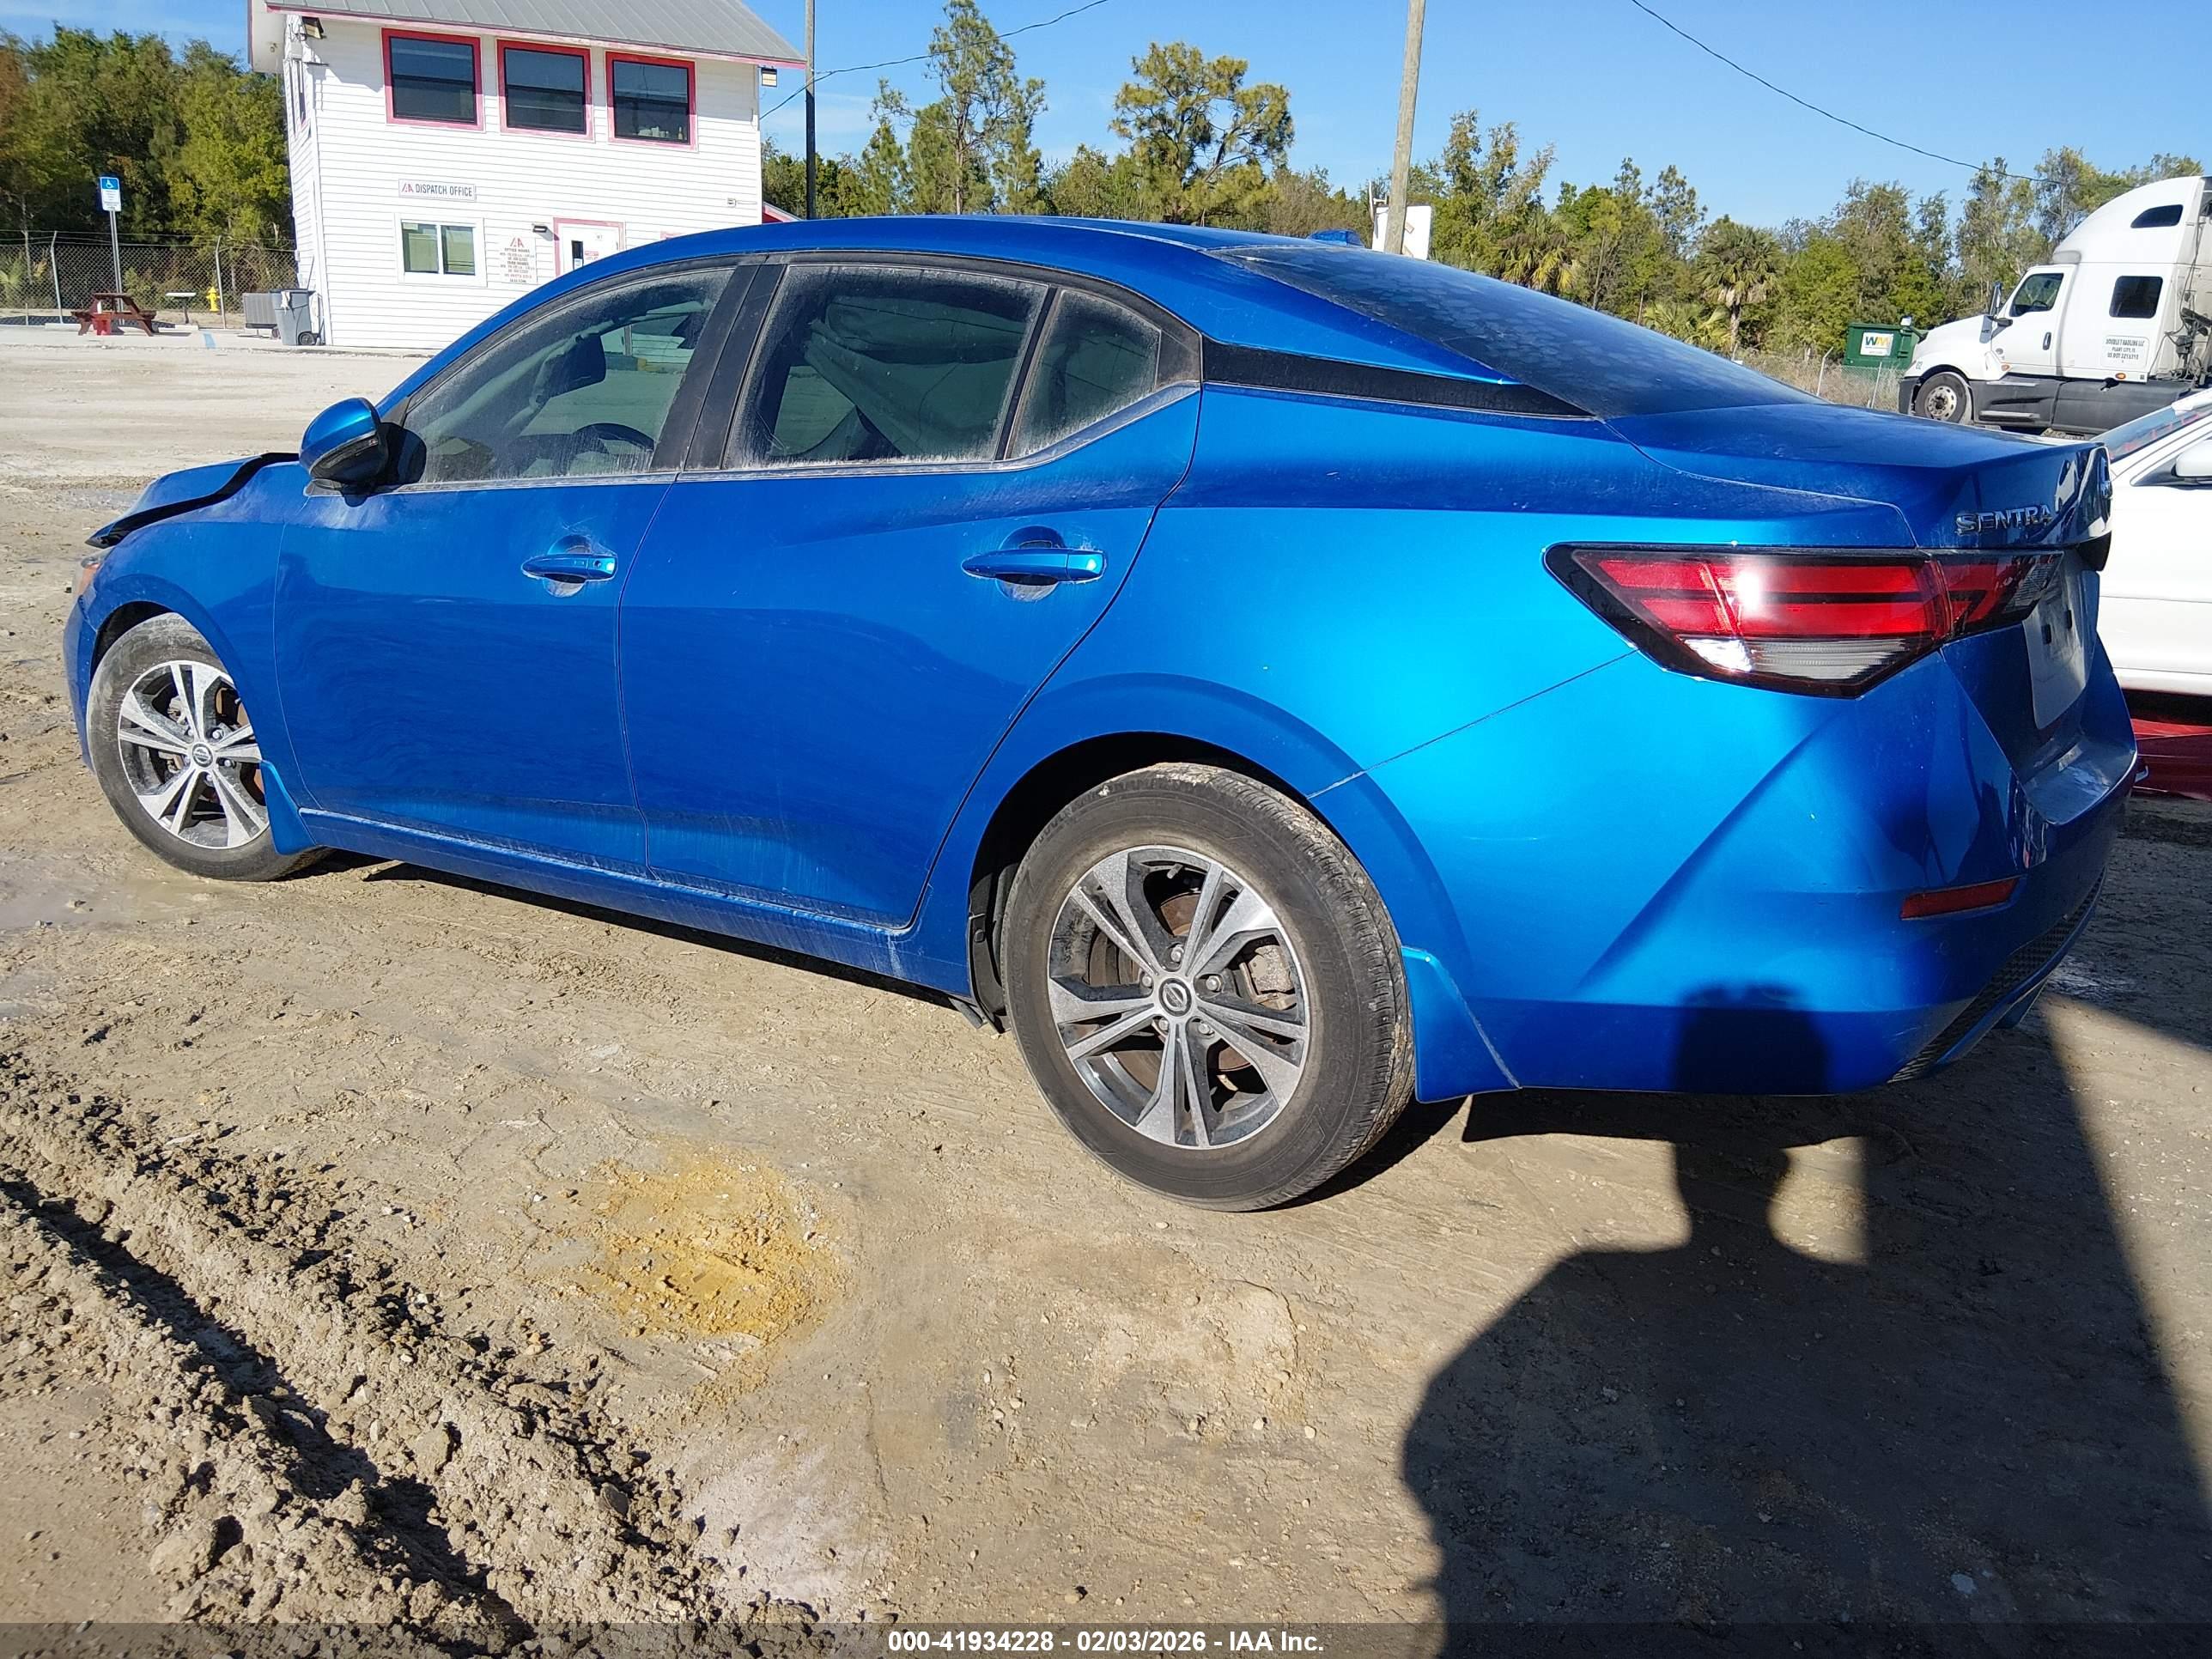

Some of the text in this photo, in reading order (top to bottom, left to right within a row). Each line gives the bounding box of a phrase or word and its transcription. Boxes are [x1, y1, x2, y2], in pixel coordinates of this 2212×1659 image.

[415, 184, 447, 195] DISPATCH
[449, 185, 472, 197] OFFICE
[1865, 336, 1890, 346] WM
[1955, 504, 2053, 537] SENTRA
